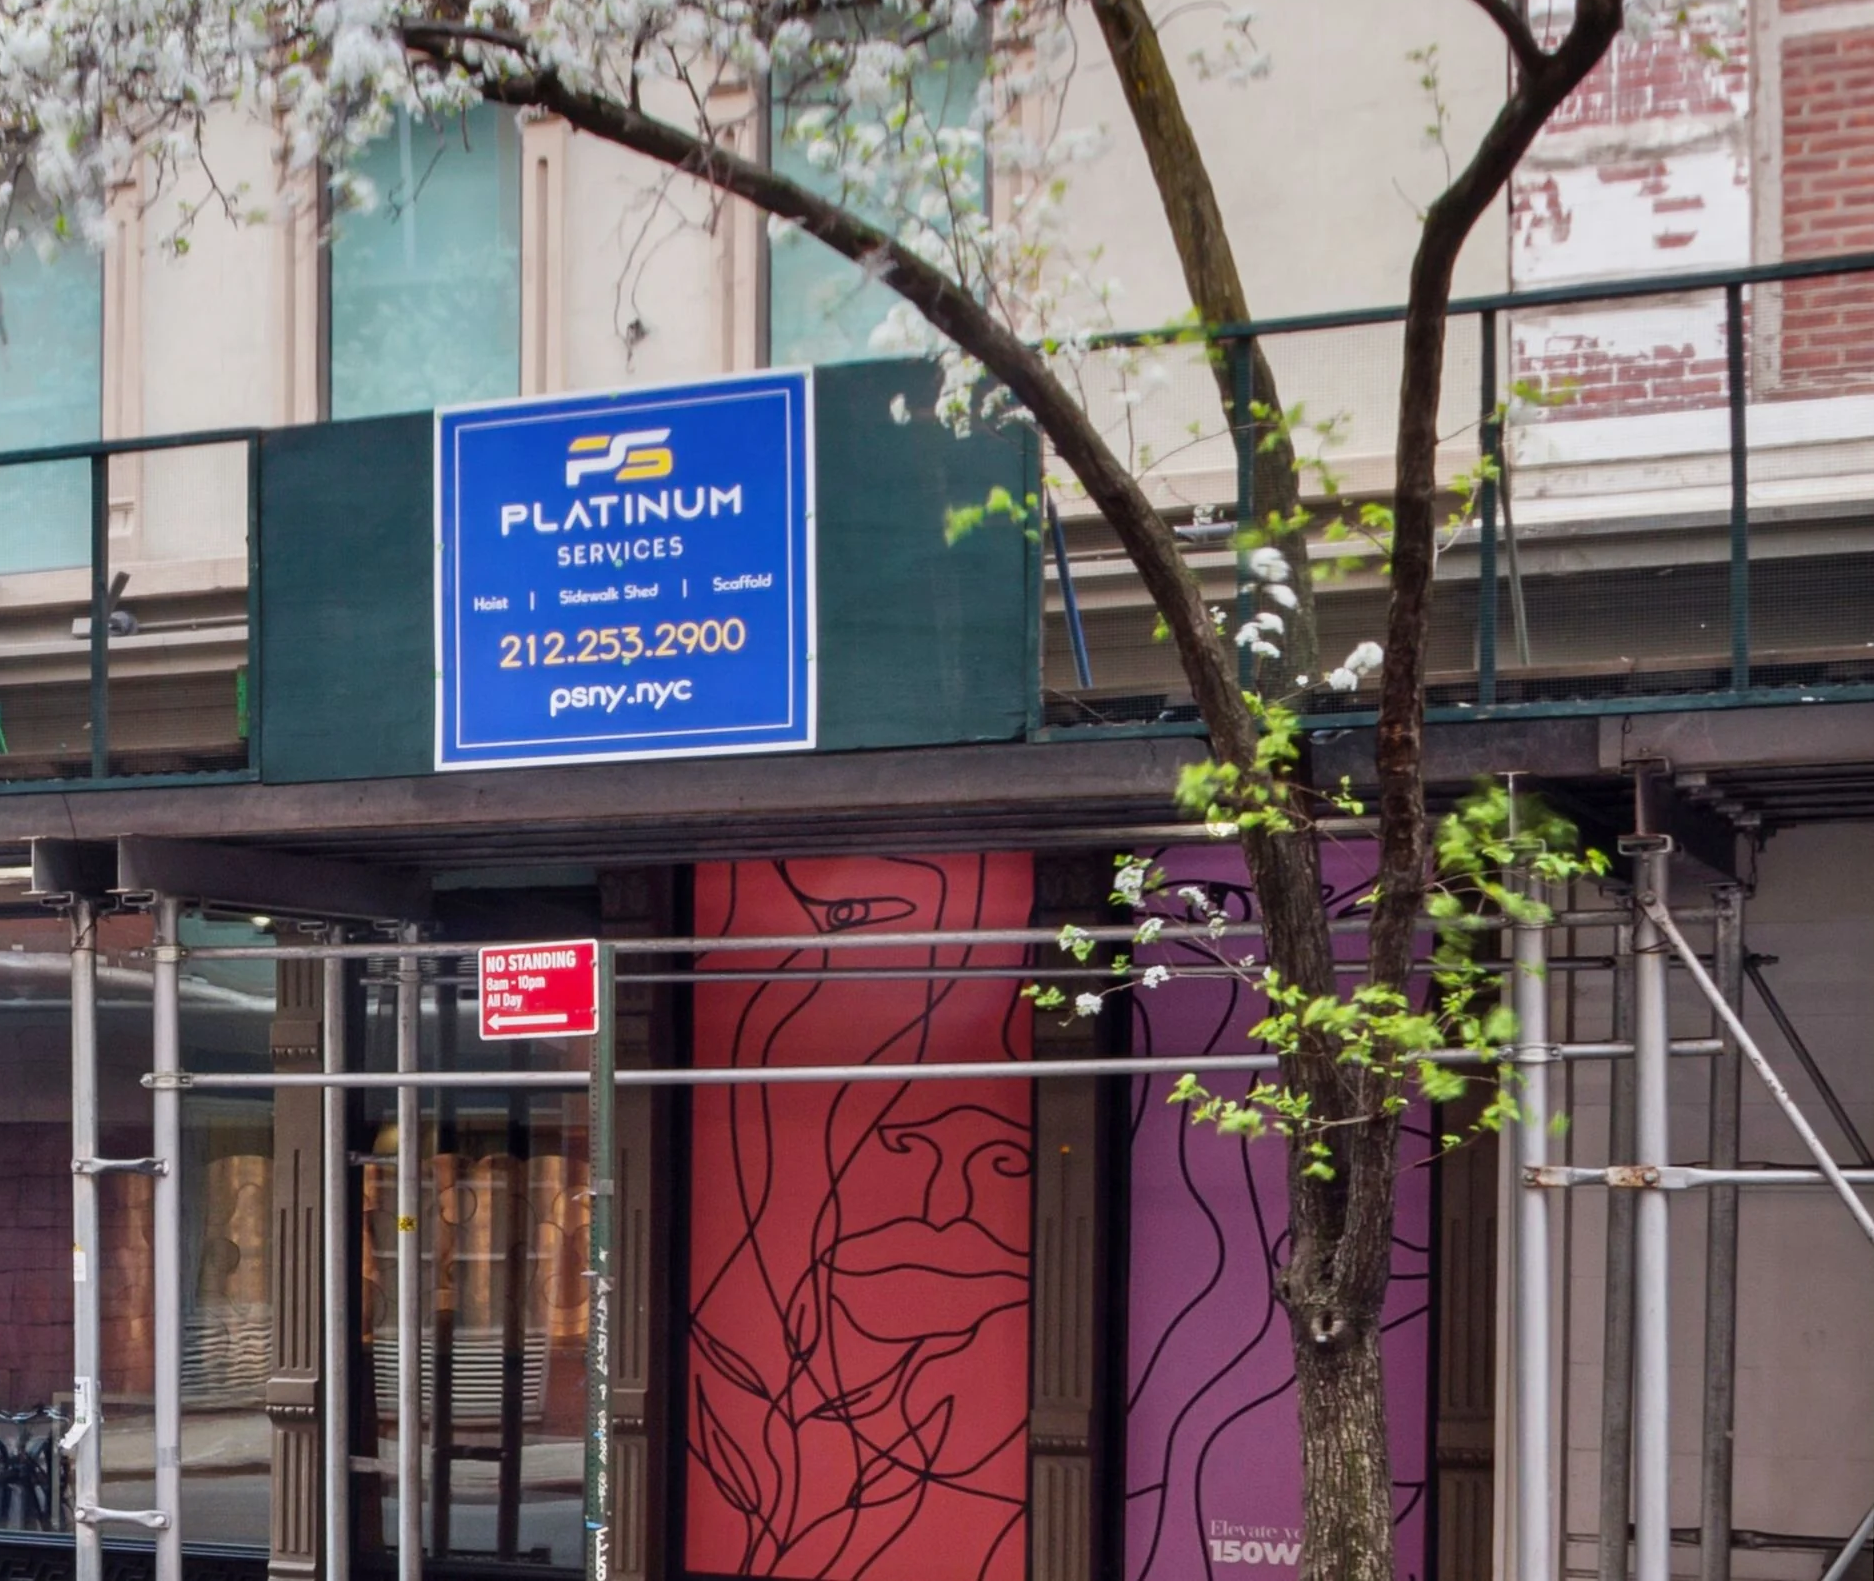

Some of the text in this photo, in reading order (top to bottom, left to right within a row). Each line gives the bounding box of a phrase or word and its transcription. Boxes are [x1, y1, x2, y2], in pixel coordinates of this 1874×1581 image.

[501, 484, 743, 536] PLATINUM
[557, 536, 684, 566] SERVICES
[473, 573, 773, 612] Hoist Sidewalk Shed Scaffold
[499, 618, 746, 669] 212.253.2900
[549, 678, 693, 717] psny.nyc
[485, 950, 576, 973] NO STANDING
[485, 977, 509, 990] 8am
[518, 975, 546, 992] 10pm
[487, 992, 523, 1009] All Day
[1210, 1519, 1278, 1538] Elevate
[1208, 1538, 1303, 1566] 150W
